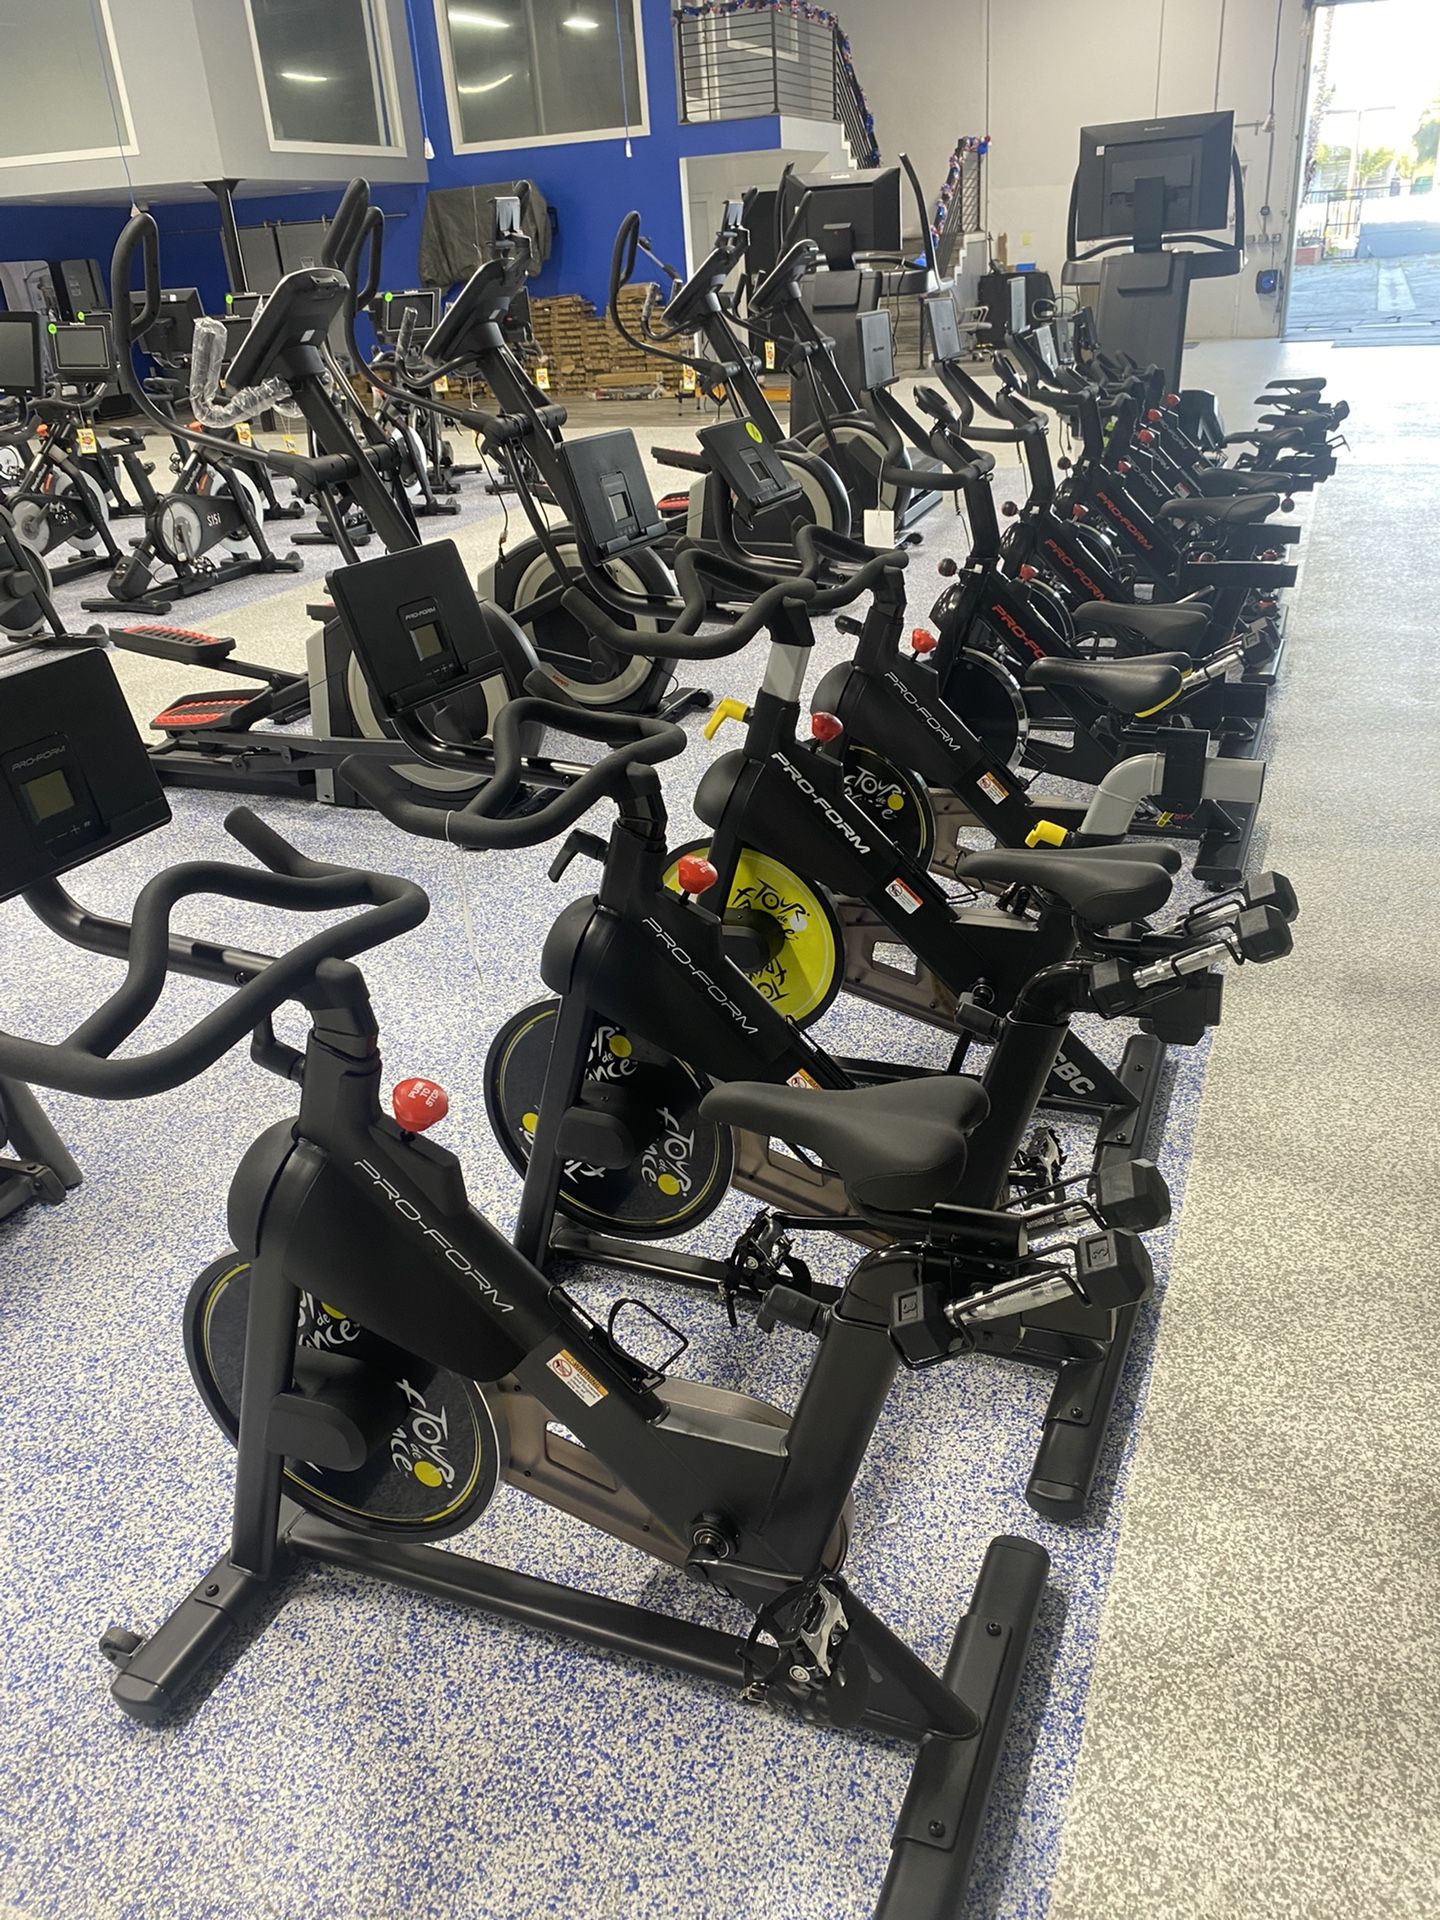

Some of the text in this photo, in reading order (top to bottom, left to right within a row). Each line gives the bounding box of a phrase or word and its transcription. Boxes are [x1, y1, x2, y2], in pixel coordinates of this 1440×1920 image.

[1097, 491, 1152, 551] PRO-FORM
[992, 604, 1047, 659] PRO-FO
[884, 671, 961, 752] PRO-FORM
[12, 745, 65, 772] PRO-FORM
[771, 751, 871, 854] PRO-FORM
[642, 916, 759, 1034] PRO-FORM
[602, 1050, 614, 1063] de
[419, 1087, 431, 1098] TO
[425, 1088, 439, 1107] STOP
[354, 1159, 515, 1313] PRO-FORM
[316, 1311, 330, 1326] de
[410, 1443, 426, 1459] de
